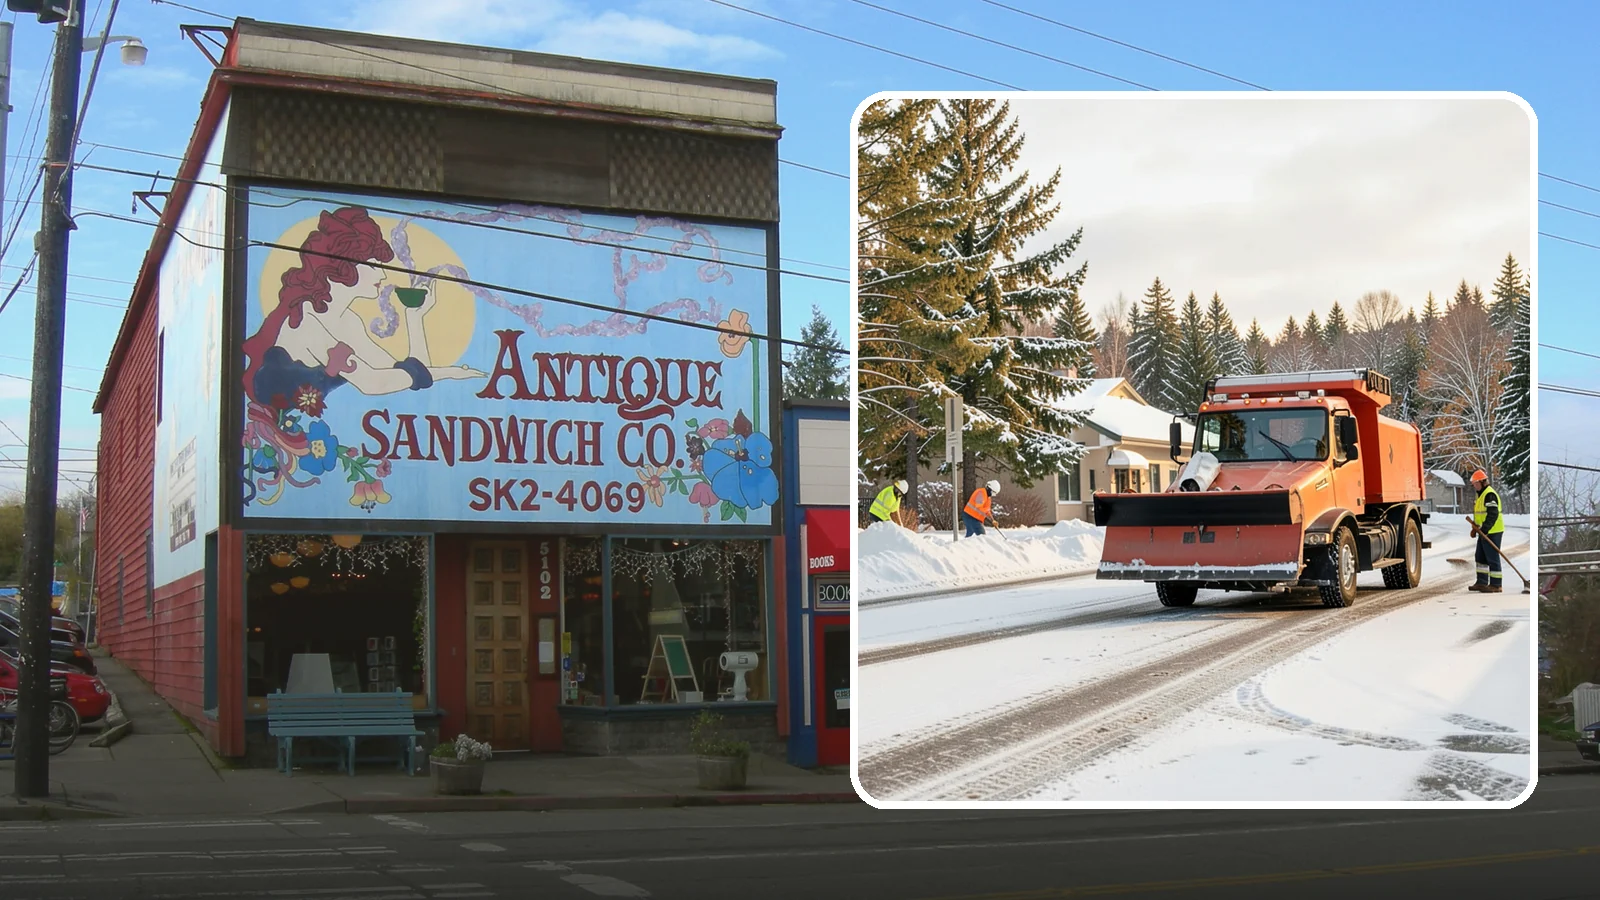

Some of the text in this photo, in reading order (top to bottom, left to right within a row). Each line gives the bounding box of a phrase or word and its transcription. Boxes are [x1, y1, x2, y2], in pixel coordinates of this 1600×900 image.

[476, 329, 724, 420] ANTIQUE
[361, 409, 685, 468] SANDWICH CO.
[468, 477, 646, 512] SK2-4069
[539, 542, 551, 599] 5102
[809, 555, 834, 568] BOOKS
